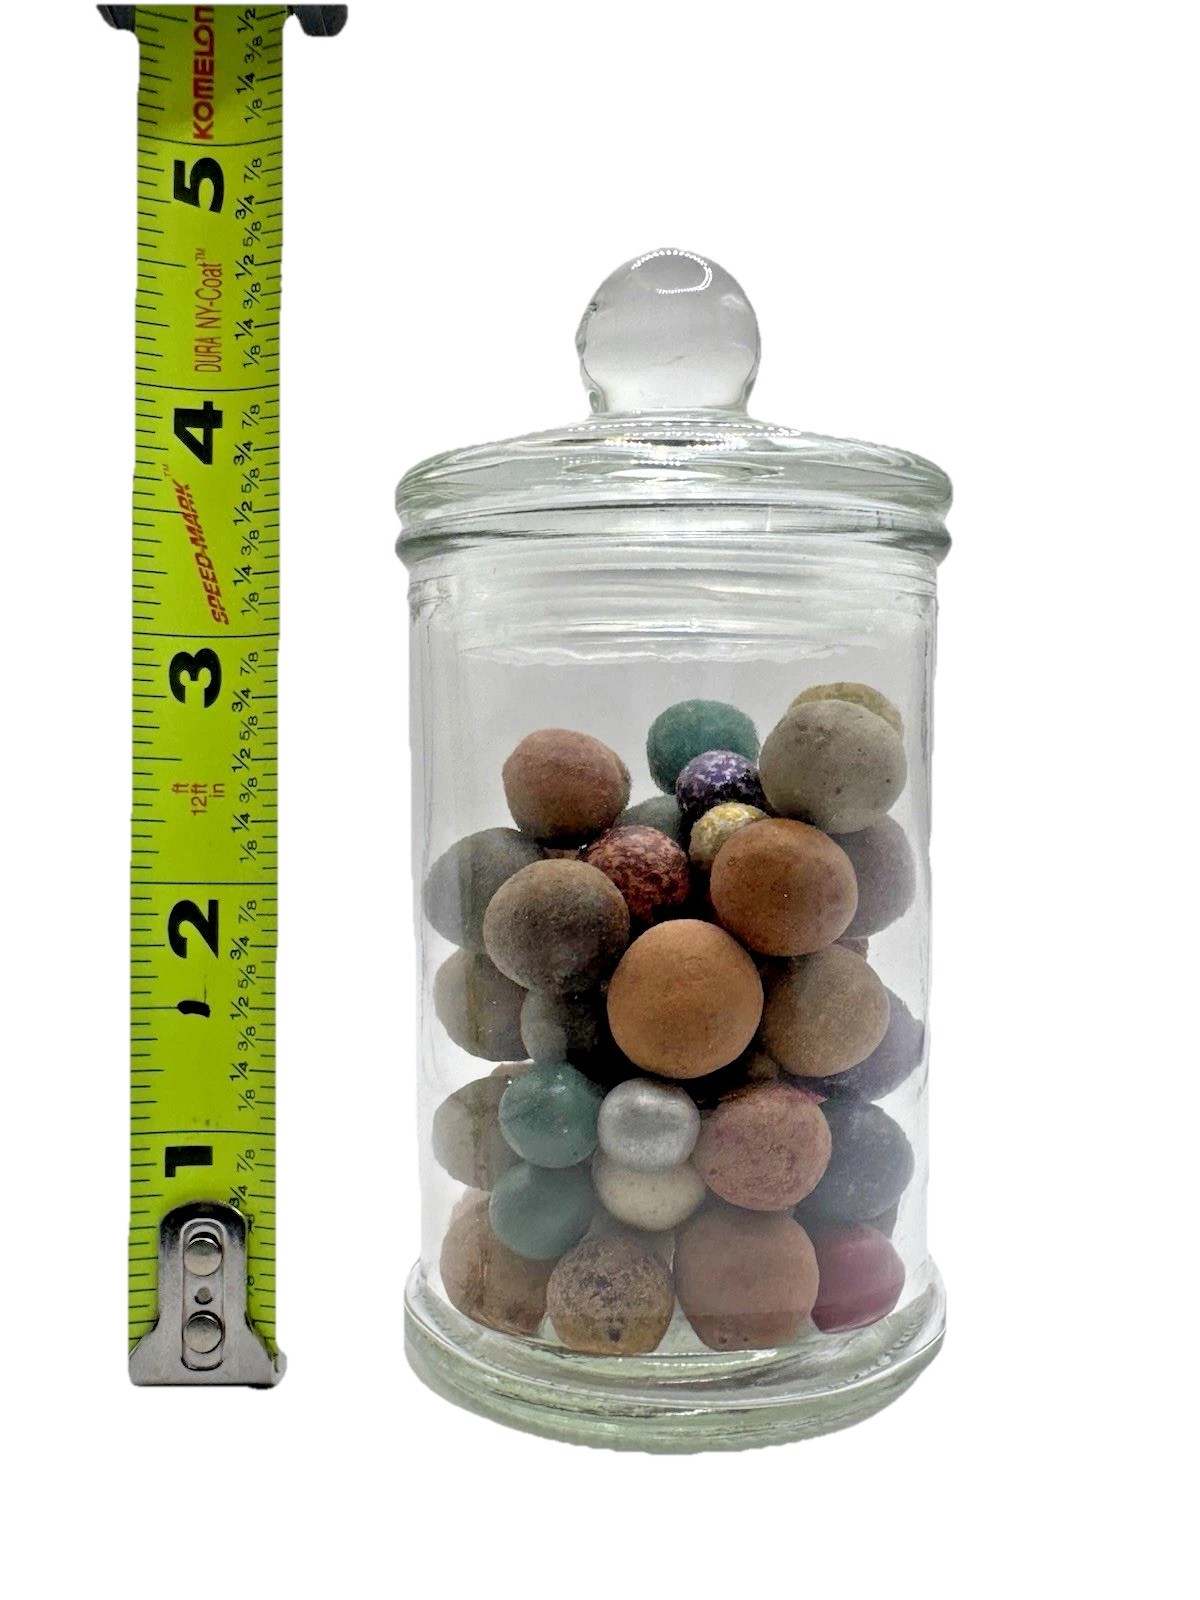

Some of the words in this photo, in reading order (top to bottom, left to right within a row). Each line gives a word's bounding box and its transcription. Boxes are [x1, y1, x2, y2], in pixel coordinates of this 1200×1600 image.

[236, 8, 257, 33] 1/2
[244, 35, 263, 64] 3/8
[236, 72, 256, 94] 1/4
[244, 98, 263, 123] 1/8
[243, 157, 263, 183] 7/8
[173, 156, 225, 214] 5
[235, 194, 256, 220] 3/4
[242, 220, 262, 247] 5/8
[235, 254, 255, 279] 1/2
[242, 282, 261, 310] 3/8
[234, 318, 254, 340] 1/4
[194, 336, 222, 373] DURA
[242, 345, 261, 368] 1/8
[242, 404, 260, 430] 7/8
[174, 401, 223, 465] 4
[233, 441, 253, 466] 3/4
[241, 468, 260, 493] 5/8
[233, 501, 253, 526] 1/2
[241, 529, 260, 555] 3/8
[233, 564, 253, 586] 1/4
[241, 592, 260, 616] 1/8
[240, 652, 259, 676] 7/8
[169, 648, 222, 708] 3
[231, 688, 252, 713] 3/4
[239, 715, 258, 741] 5/8
[231, 748, 251, 772] 1/2
[171, 782, 189, 794] ft
[209, 782, 226, 798] in
[239, 777, 258, 803] 3/8
[231, 812, 251, 833] 1/4
[239, 839, 257, 863] 1/8
[238, 899, 257, 924] 7/8
[168, 900, 219, 959] 2
[230, 935, 250, 960] 3/4
[238, 964, 256, 989] 5/8
[230, 996, 250, 1020] 1/2
[237, 1025, 256, 1051] 3/8
[229, 1061, 249, 1081] 1/4
[237, 1089, 256, 1111] 1/8
[164, 1145, 213, 1178] 1
[237, 1149, 256, 1173] 7/8
